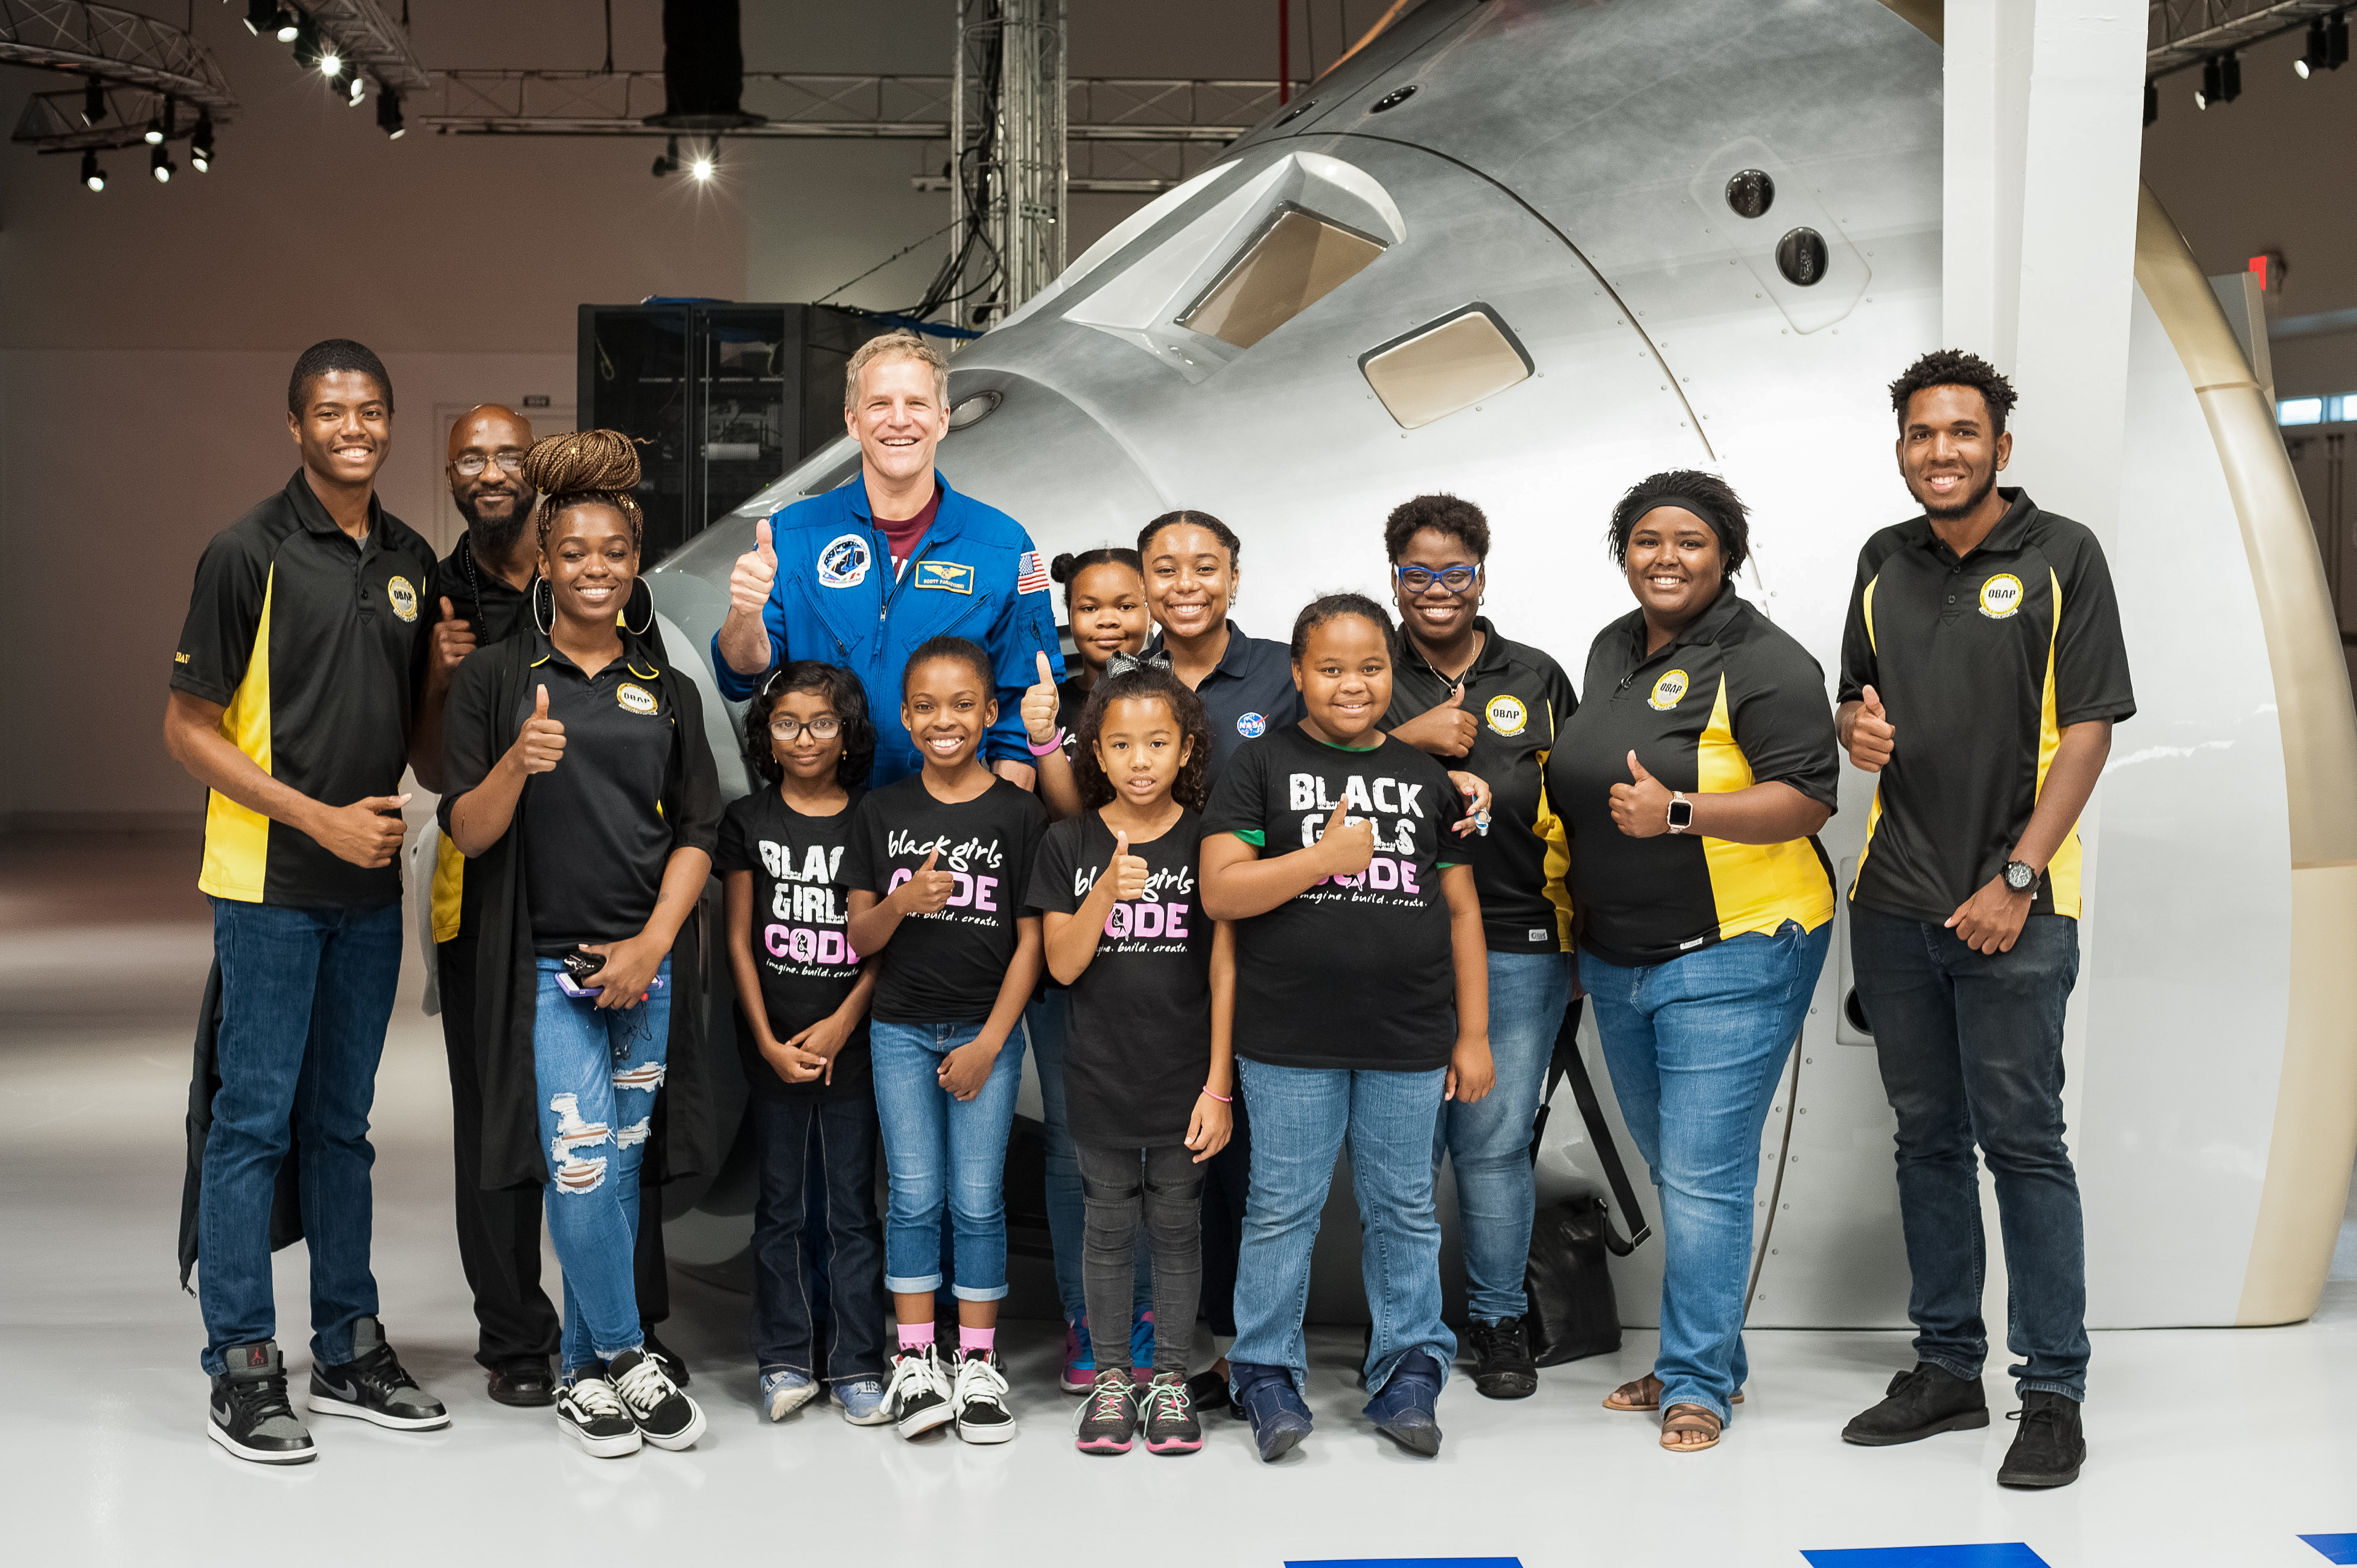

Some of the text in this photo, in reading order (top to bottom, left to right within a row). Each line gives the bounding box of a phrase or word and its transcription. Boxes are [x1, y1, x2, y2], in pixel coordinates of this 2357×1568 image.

[1988, 589, 2016, 599] OBAP
[1660, 683, 1683, 694] OBAP
[1239, 721, 1265, 734] NASA
[1493, 708, 1520, 719] OBAP
[1290, 773, 1424, 819] BLACK
[1301, 813, 1416, 855] GLS
[759, 840, 845, 885] BLA
[888, 829, 1003, 872] black girls
[888, 868, 999, 912] CDE
[1141, 865, 1195, 903] girls
[772, 882, 848, 925] GIRL
[1351, 891, 1389, 904] build.
[1392, 898, 1427, 907] create.
[961, 916, 999, 927] create.
[1104, 902, 1189, 939] ODE
[1117, 941, 1150, 953] build.
[1153, 942, 1188, 953] create.
[766, 958, 799, 975] imagine.
[801, 965, 831, 977] build.
